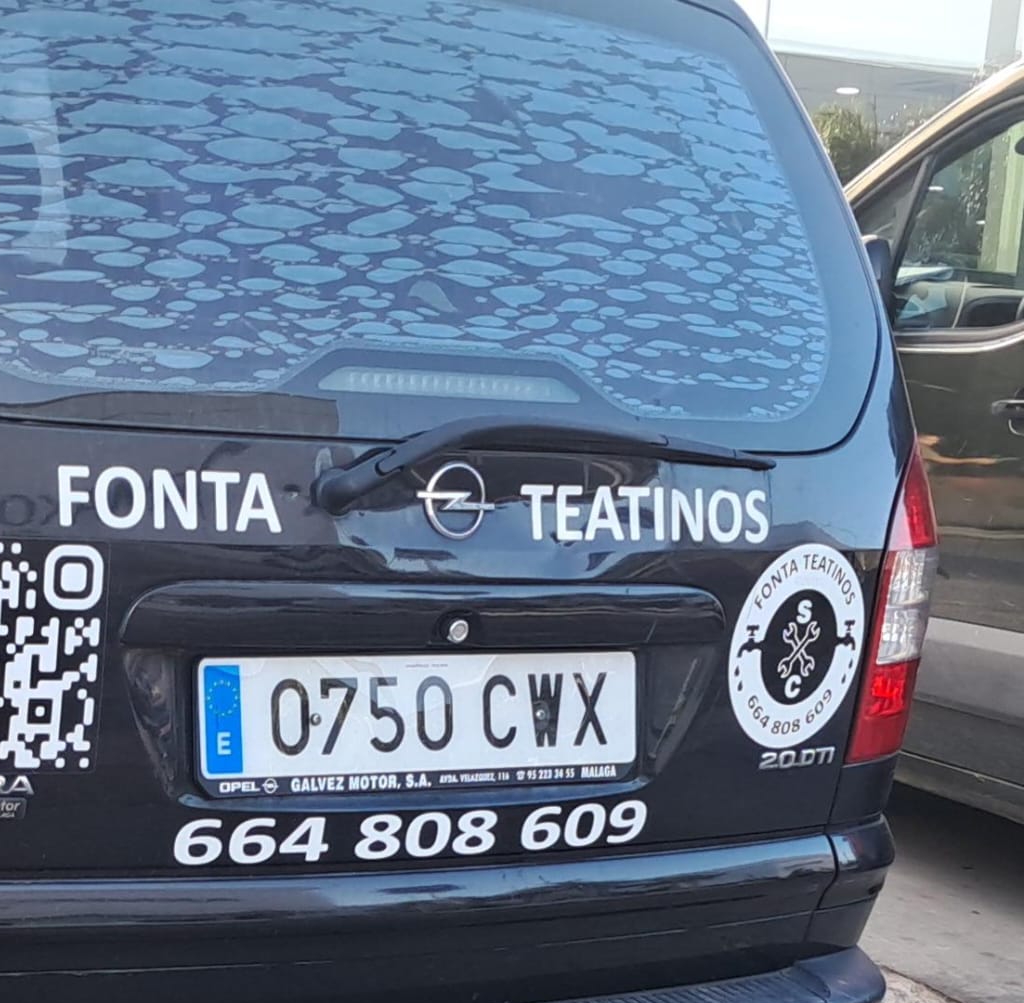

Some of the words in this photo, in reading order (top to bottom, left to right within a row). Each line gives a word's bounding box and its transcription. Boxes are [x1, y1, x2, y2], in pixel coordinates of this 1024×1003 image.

[57, 464, 282, 534] FONTA
[520, 483, 770, 544] TEATINOS
[753, 558, 799, 610] FONTA
[803, 553, 857, 606] TEATINOS
[796, 599, 813, 625] S
[783, 674, 802, 699] C
[217, 731, 231, 755] E
[270, 675, 453, 756] 0750
[482, 672, 608, 748] CWX
[747, 694, 770, 730] 664
[770, 718, 801, 735] 808
[805, 688, 833, 724] 609
[219, 780, 260, 793] OPEL
[291, 776, 344, 792] GALVEZ
[348, 774, 401, 791] MOTOR,
[405, 772, 432, 788] S.A.
[581, 765, 617, 778] MALAGA
[173, 816, 329, 866] 664
[354, 809, 498, 859] 808
[520, 799, 647, 851] 609
